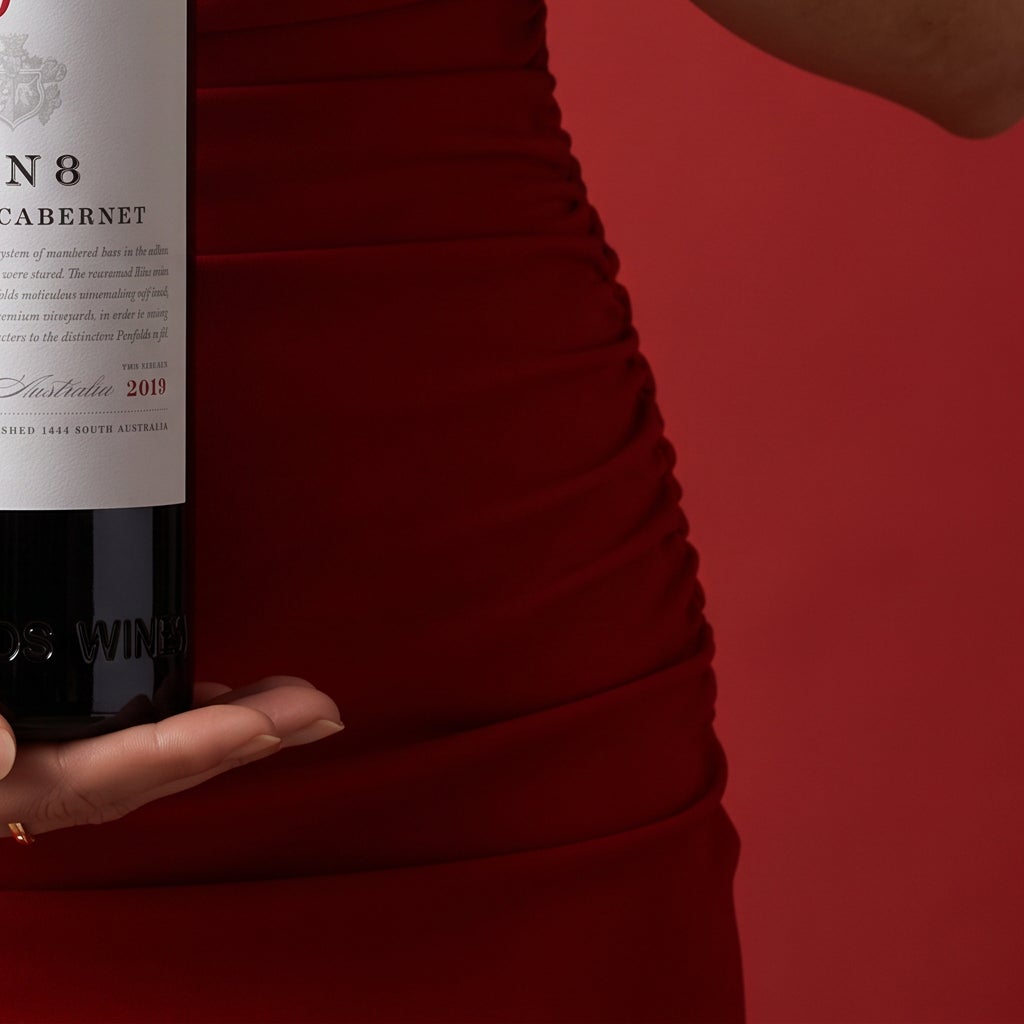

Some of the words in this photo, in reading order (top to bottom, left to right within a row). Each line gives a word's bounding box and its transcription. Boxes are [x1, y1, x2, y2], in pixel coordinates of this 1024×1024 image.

[55, 154, 81, 187] 8
[33, 248, 46, 262] of
[124, 246, 133, 257] in
[2, 271, 29, 279] were
[68, 267, 86, 279] The
[99, 309, 110, 320] in
[112, 308, 136, 320] order
[29, 333, 40, 342] to
[42, 331, 59, 342] the
[116, 329, 151, 344] Penfolds
[126, 377, 167, 397] 2019
[42, 425, 70, 435] 1444
[74, 424, 113, 434] SOUTH
[117, 422, 169, 433] AUSTRALIA
